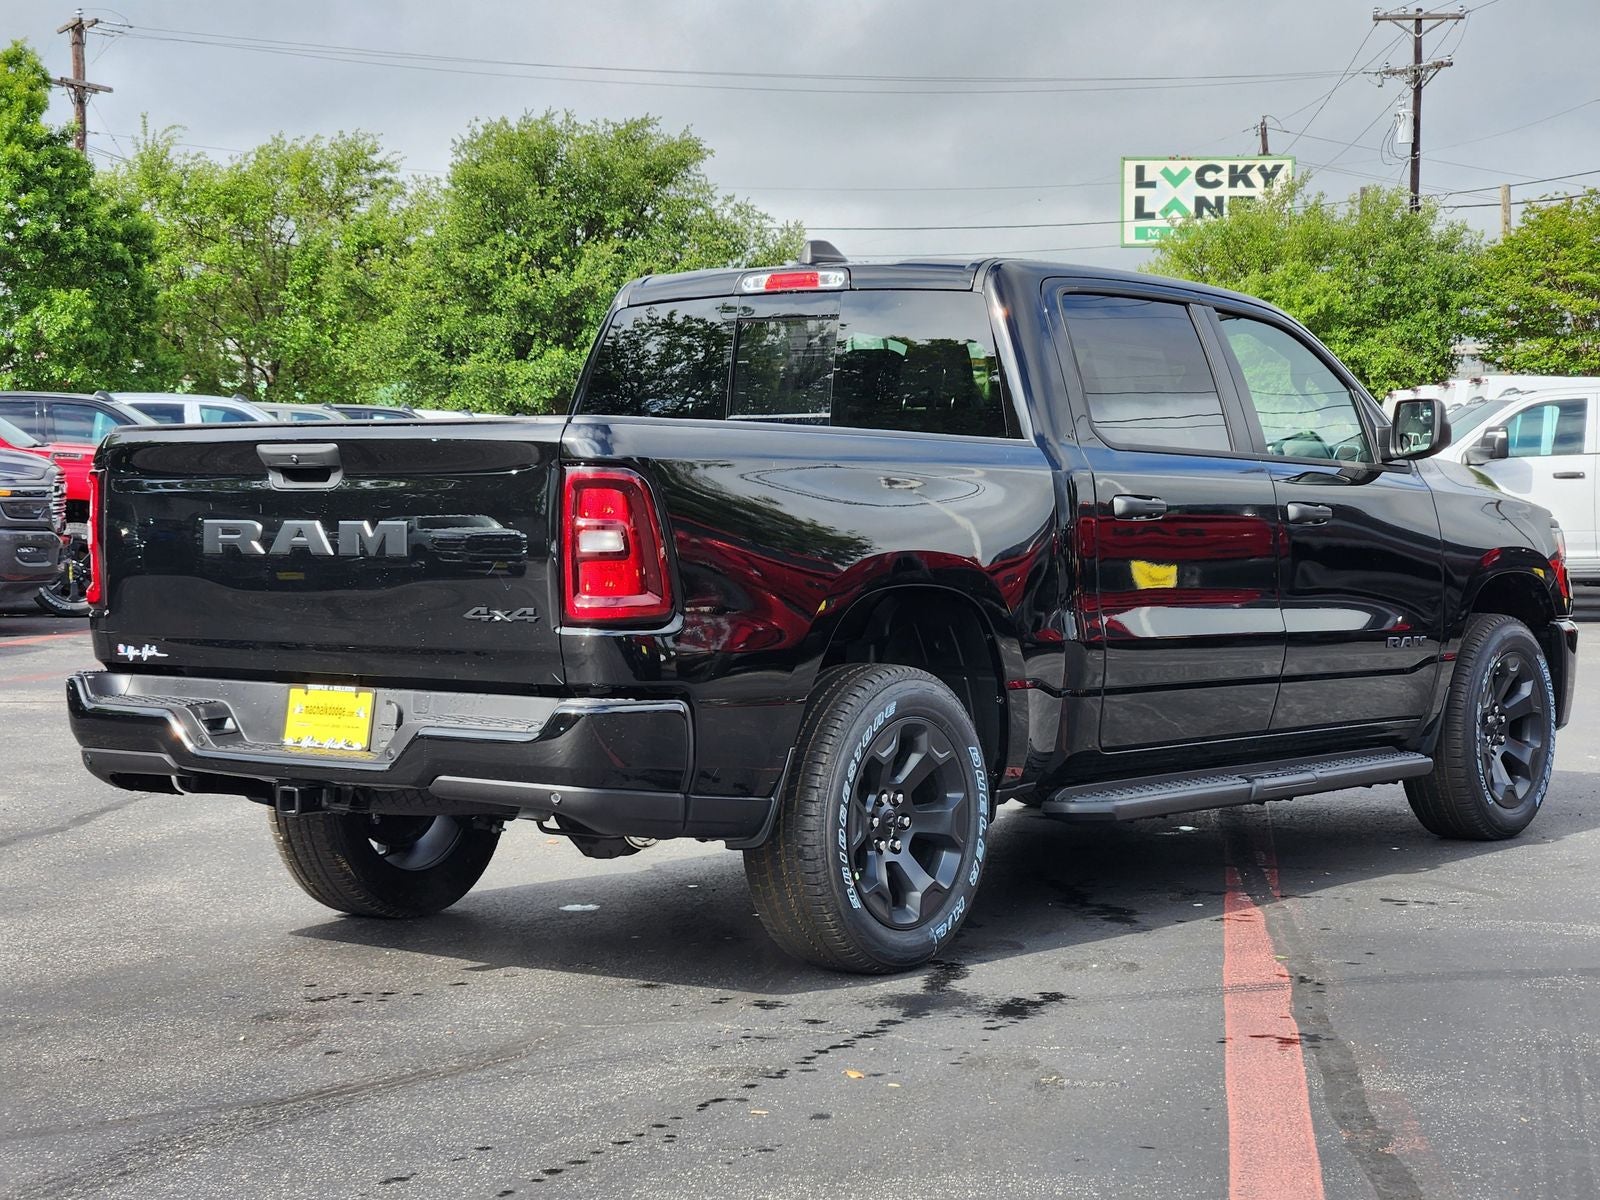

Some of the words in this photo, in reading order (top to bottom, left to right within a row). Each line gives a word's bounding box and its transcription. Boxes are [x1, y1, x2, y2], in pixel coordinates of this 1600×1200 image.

[1135, 164, 1285, 190] LUCKY
[1134, 195, 1257, 220] LAN
[203, 519, 409, 557] RAM
[463, 606, 541, 624] 4x4
[1385, 635, 1428, 649] RAM
[838, 701, 897, 909] BRIDGESTONE
[968, 746, 988, 887] DUELER
